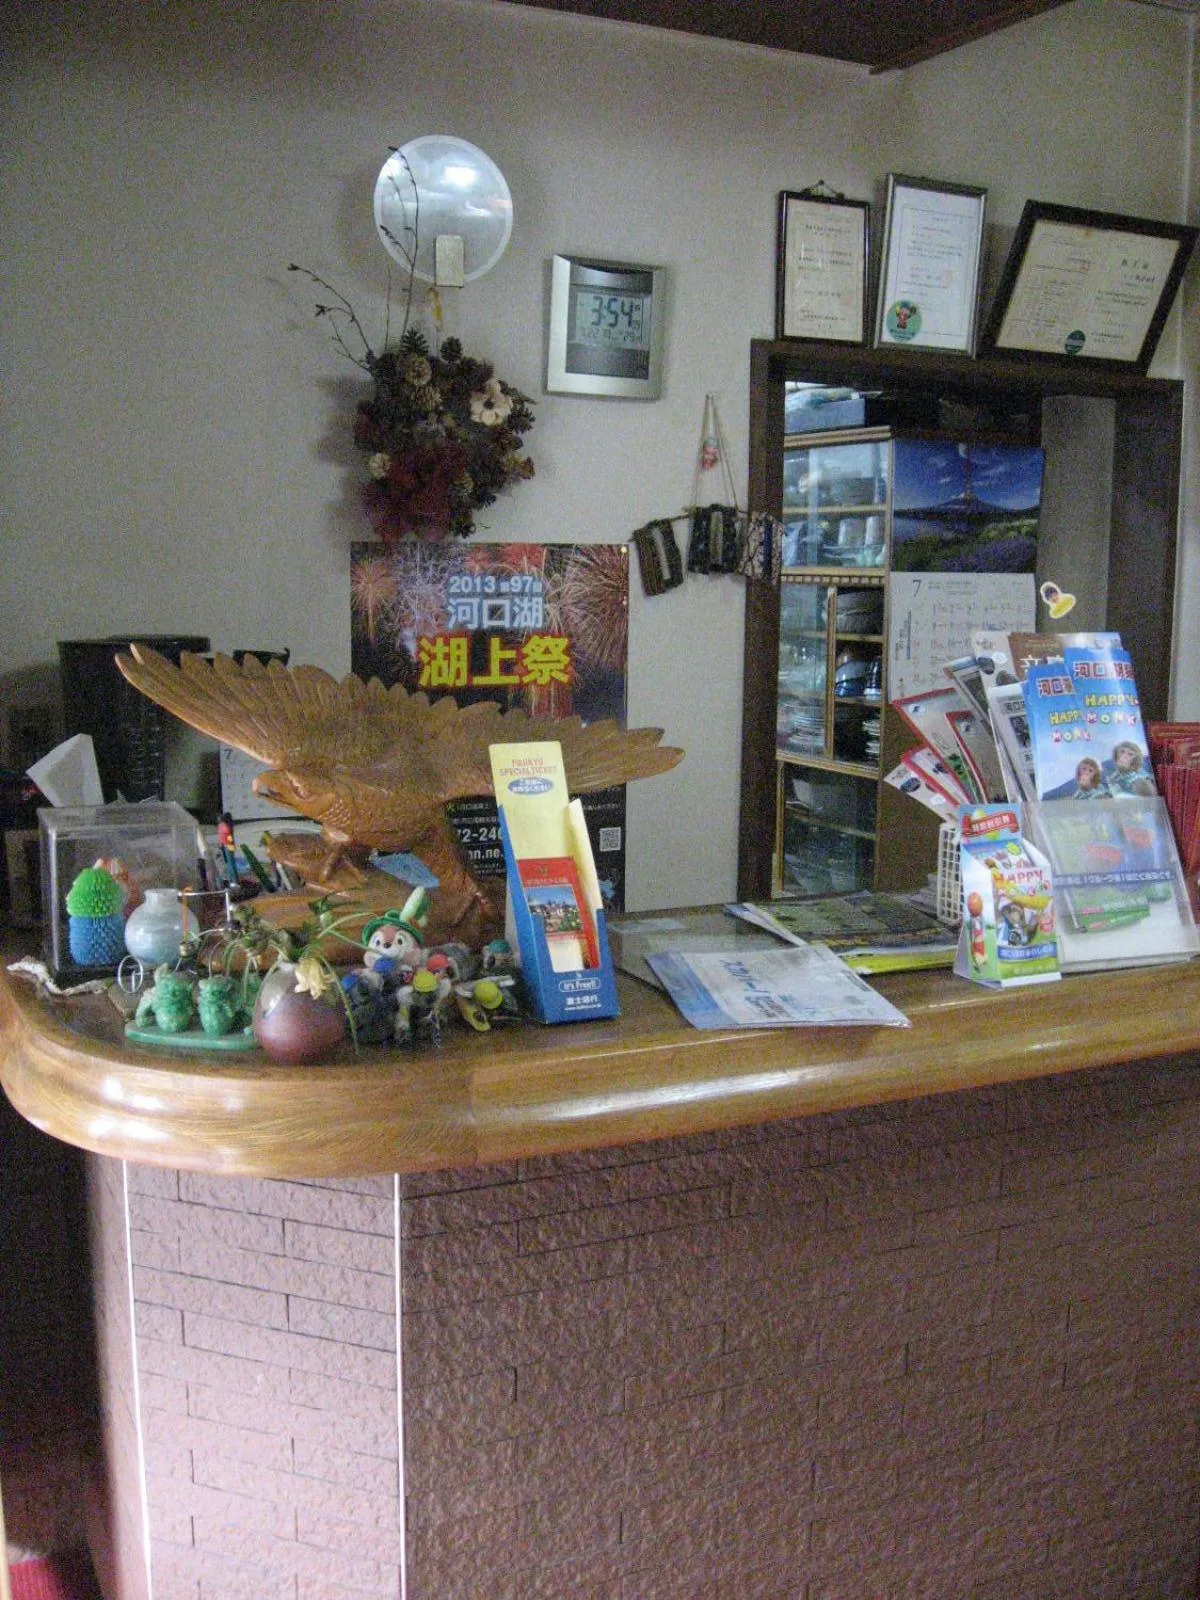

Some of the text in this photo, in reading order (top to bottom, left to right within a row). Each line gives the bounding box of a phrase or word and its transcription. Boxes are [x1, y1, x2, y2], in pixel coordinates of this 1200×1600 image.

[449, 575, 496, 593] 2013
[912, 579, 922, 597] 7
[447, 597, 543, 629] 河口湖
[418, 635, 570, 687] 湖上祭
